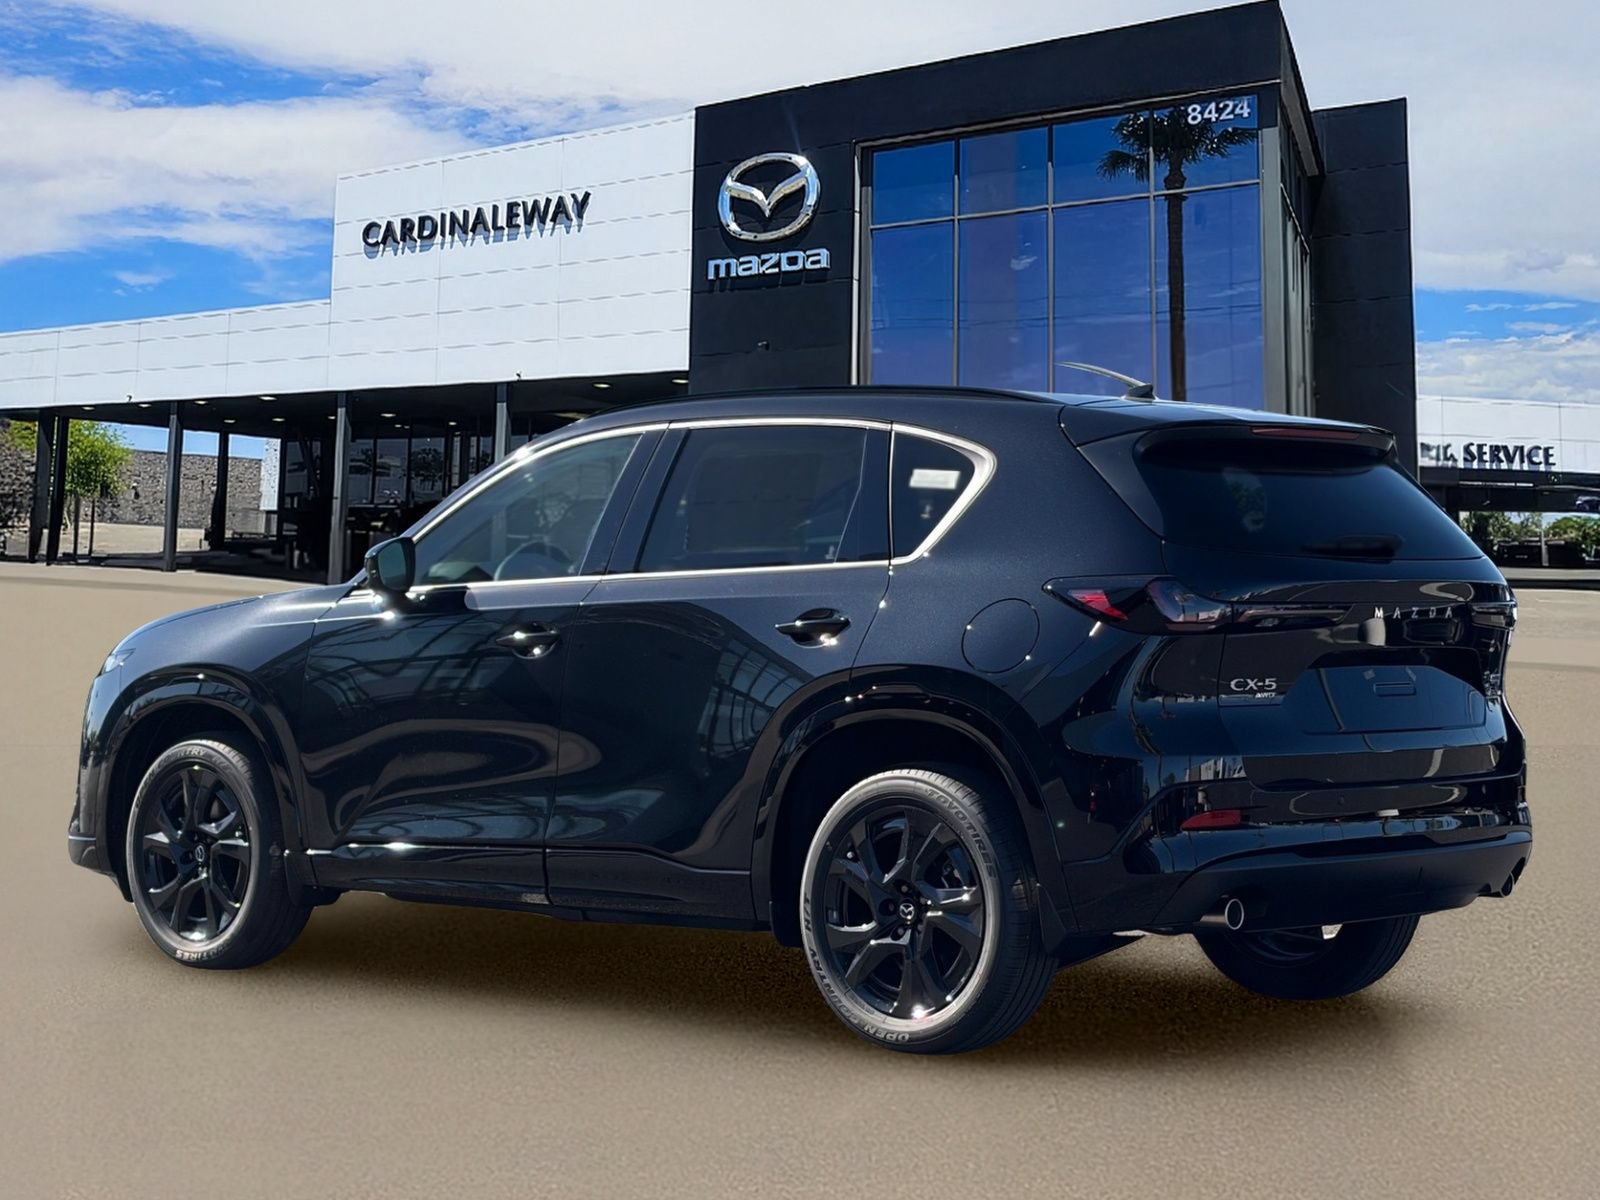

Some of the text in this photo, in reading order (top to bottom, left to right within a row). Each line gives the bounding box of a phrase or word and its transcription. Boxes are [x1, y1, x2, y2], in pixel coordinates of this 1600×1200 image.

[1187, 99, 1251, 125] 8424
[362, 190, 592, 248] CARDINALEWAY
[1462, 442, 1556, 466] SERVICE
[1374, 606, 1453, 619] MAZDA
[1230, 678, 1278, 691] CX-5
[809, 948, 860, 1025] COUNTRY
[863, 1024, 910, 1043] OPEN
